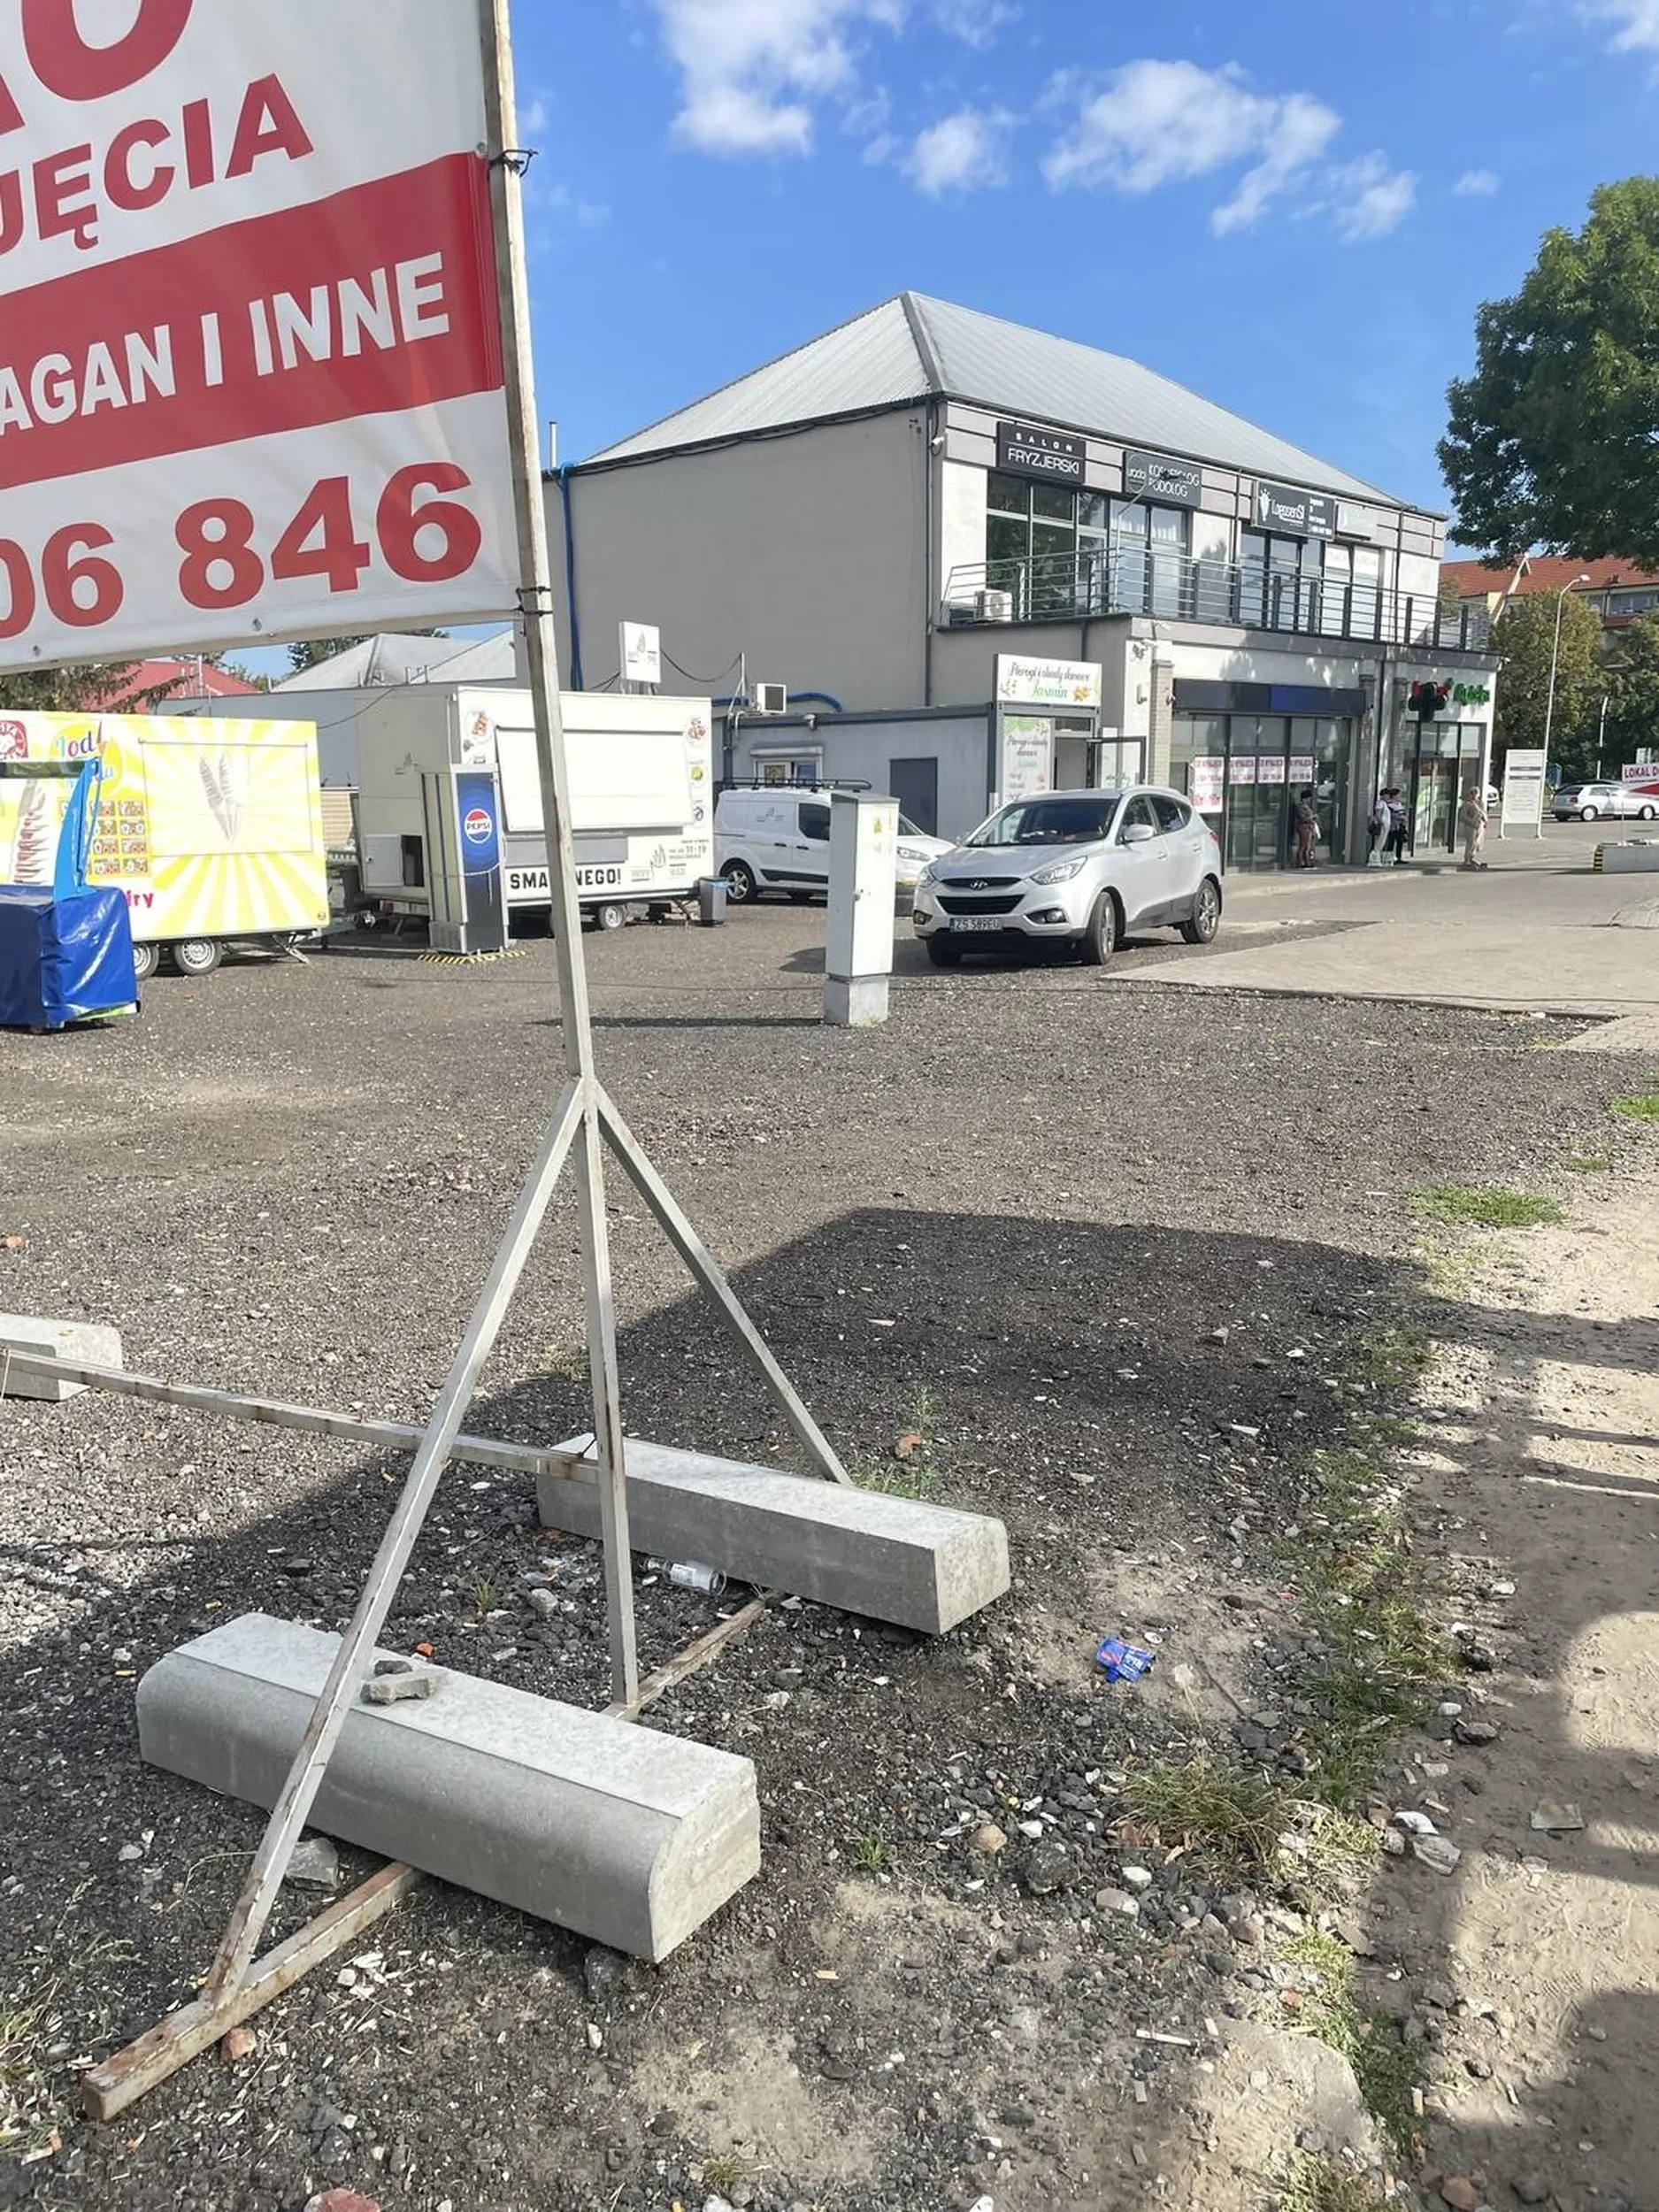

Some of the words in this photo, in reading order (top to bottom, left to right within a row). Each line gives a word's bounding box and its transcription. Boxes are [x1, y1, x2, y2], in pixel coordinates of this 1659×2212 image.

[0, 323, 177, 435] AGAN
[200, 312, 224, 387] I
[249, 251, 449, 376] INNE
[1016, 432, 1072, 452] SALON
[1008, 447, 1079, 474] FRYZJERSKI
[174, 461, 482, 610] 846
[1624, 764, 1650, 779] LOKAL
[510, 868, 621, 889] SMANEGO!
